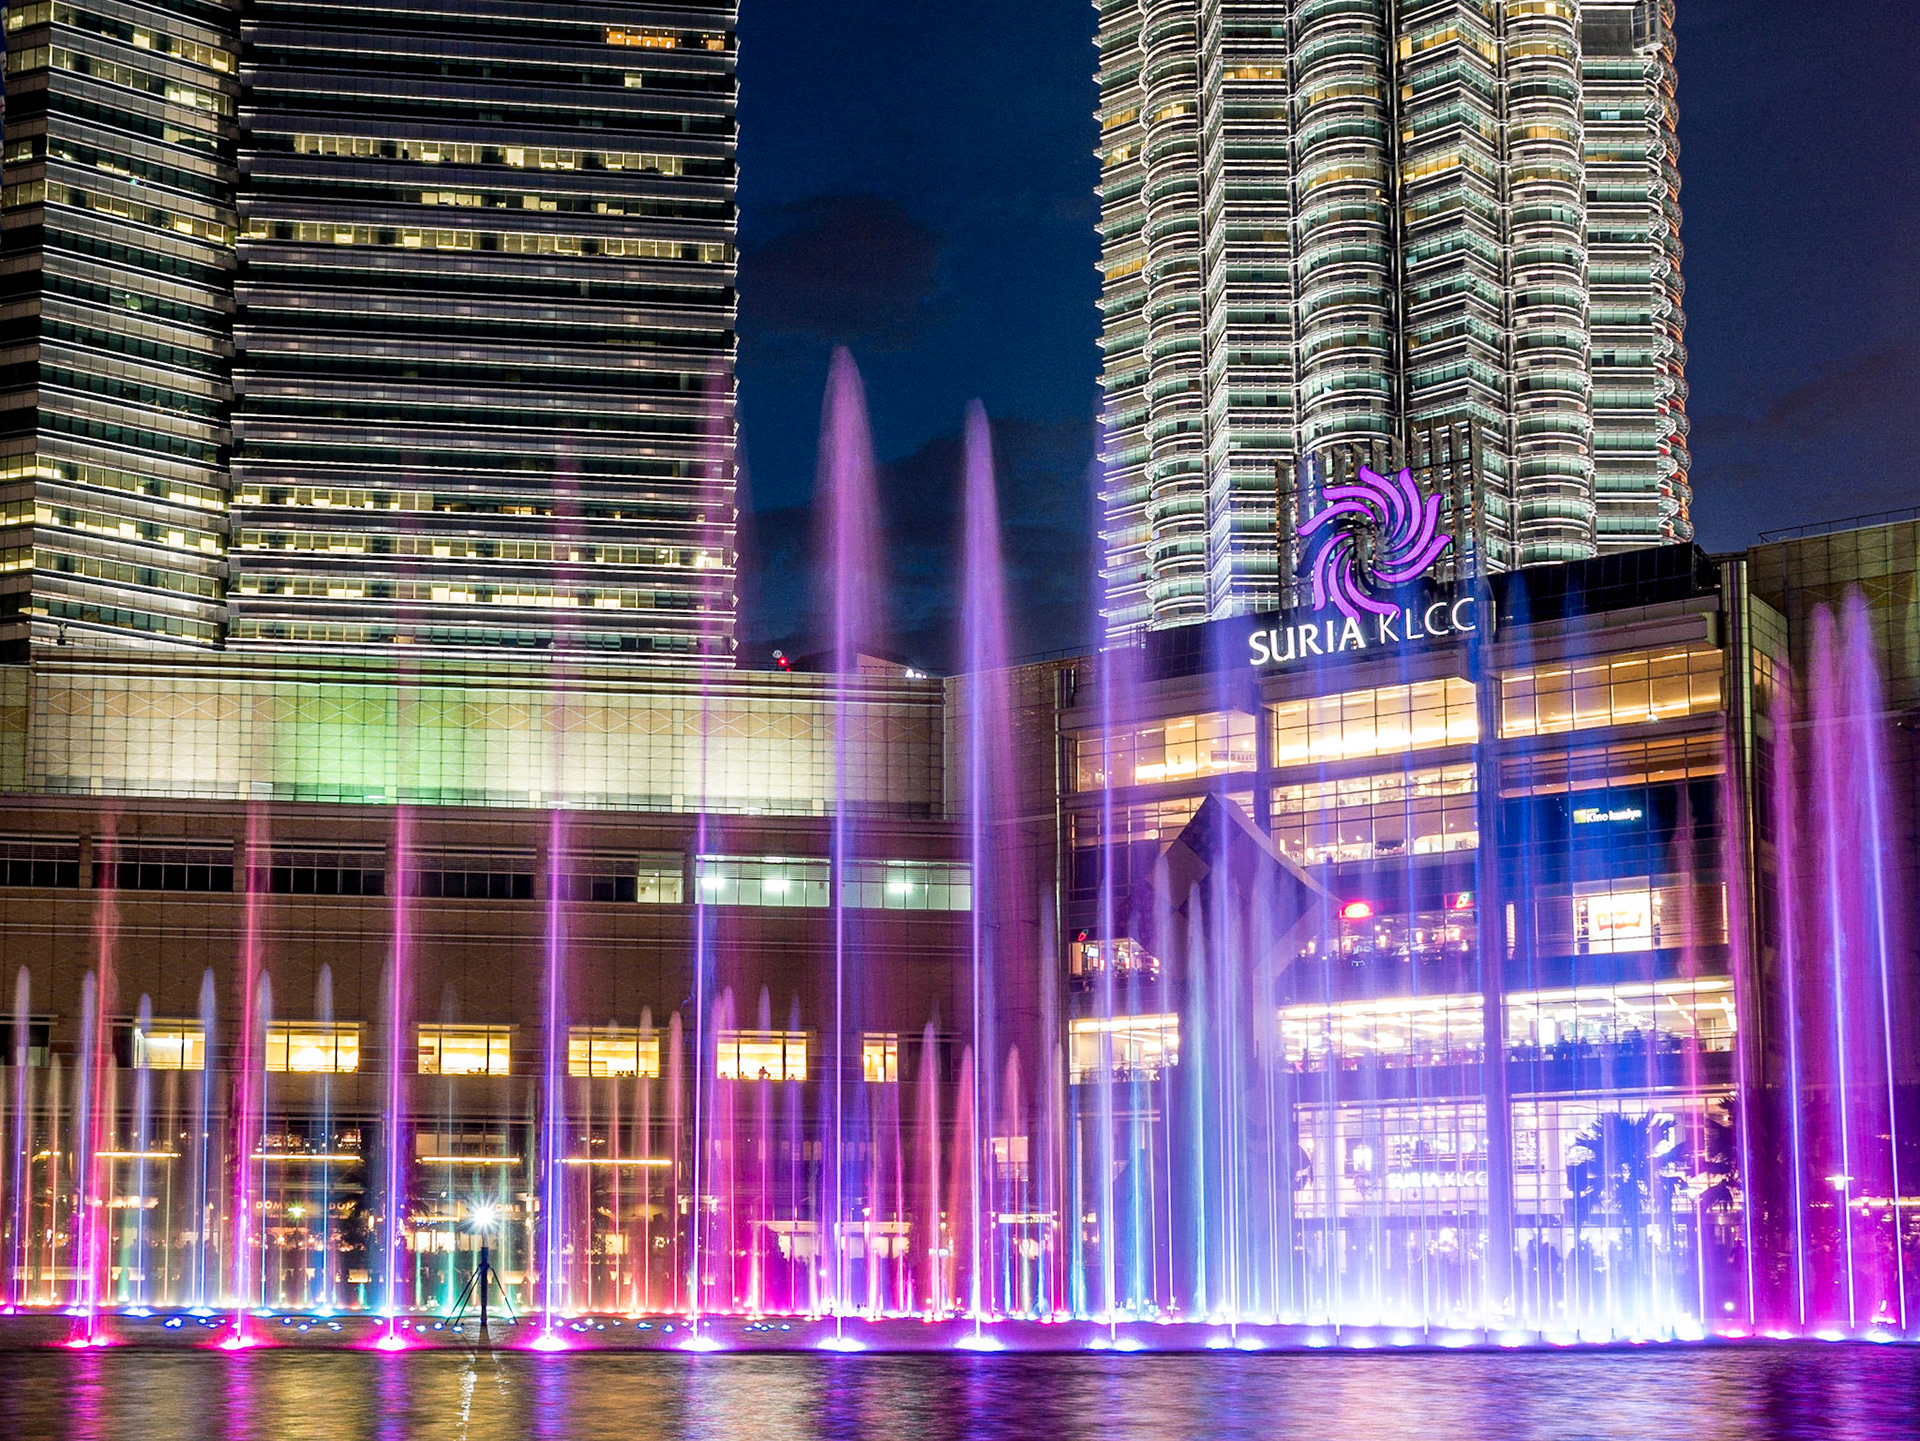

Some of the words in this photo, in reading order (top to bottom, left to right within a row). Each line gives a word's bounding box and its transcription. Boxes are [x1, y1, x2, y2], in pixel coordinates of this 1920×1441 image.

[1249, 617, 1366, 665] SURIA
[1379, 597, 1476, 644] KLCC
[1387, 1171, 1442, 1189] SURIA
[1444, 1171, 1488, 1187] KLCC
